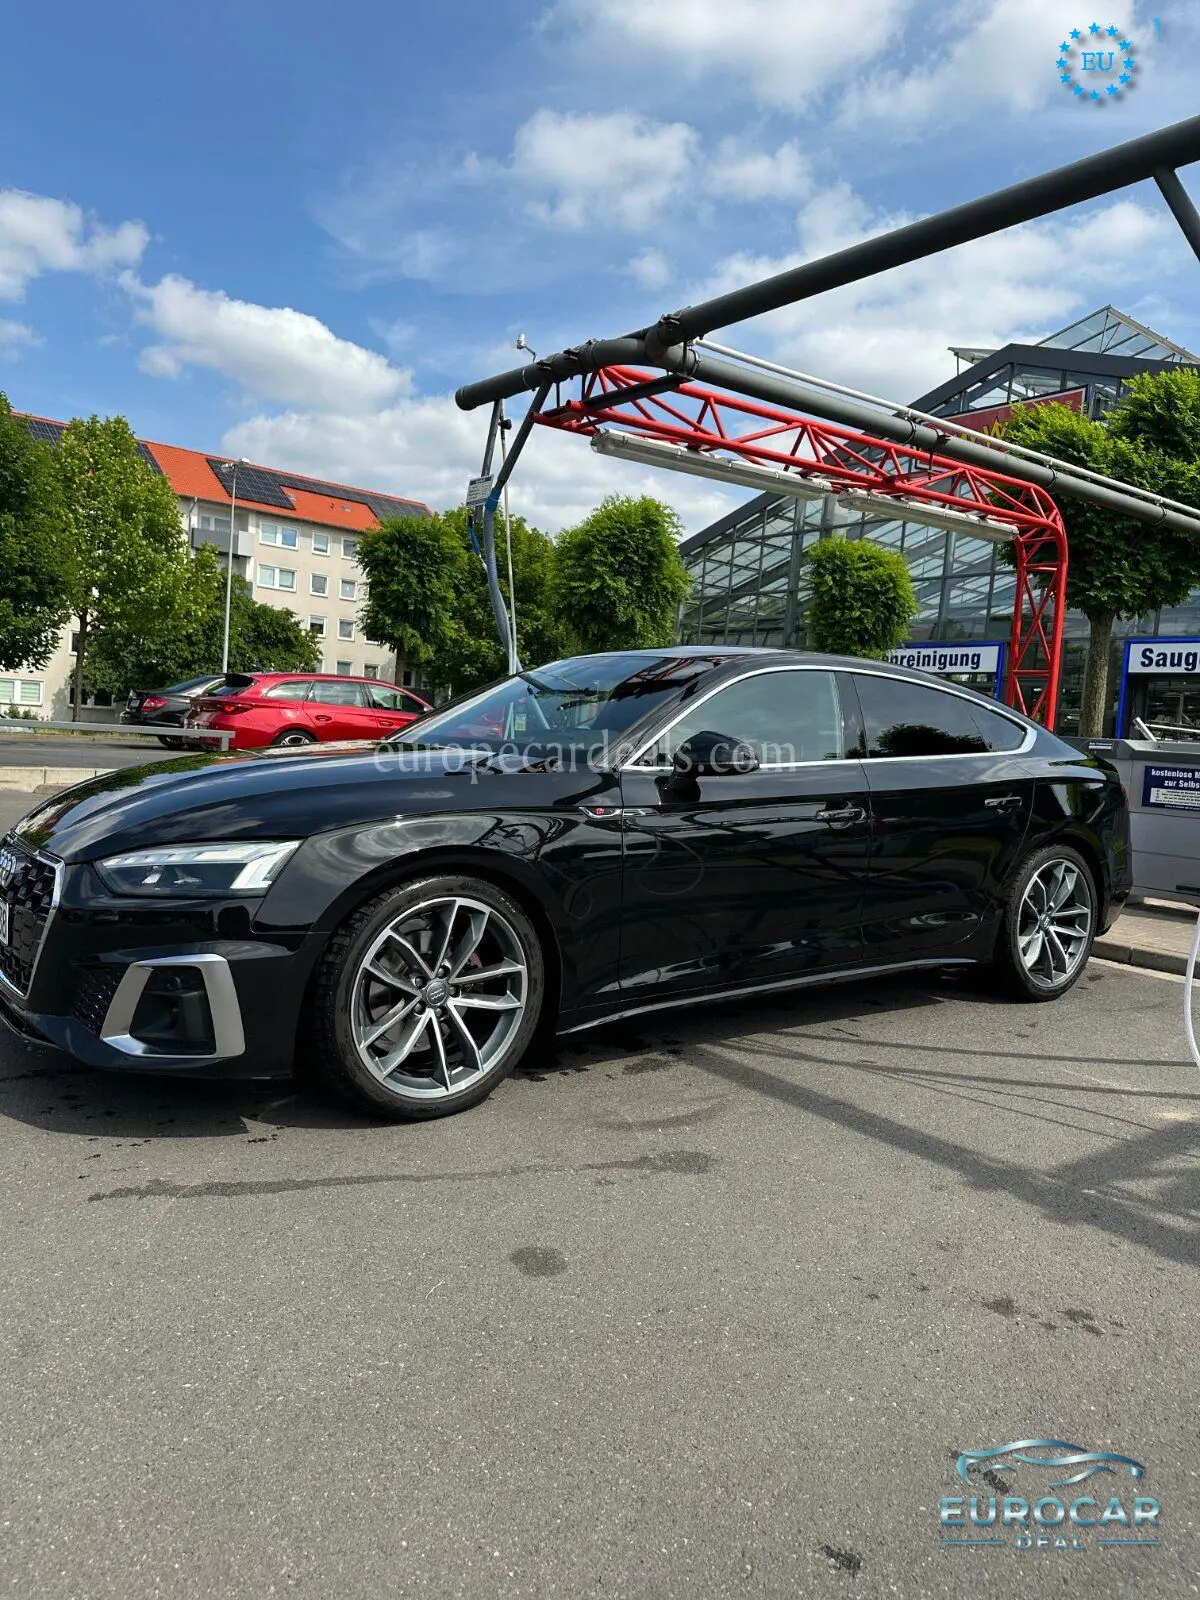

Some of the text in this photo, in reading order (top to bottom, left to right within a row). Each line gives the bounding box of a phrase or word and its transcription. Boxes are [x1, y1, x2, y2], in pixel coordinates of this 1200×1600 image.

[885, 651, 981, 670] nreinigung
[1140, 647, 1200, 671] Saug
[1151, 769, 1192, 778] kostenlose
